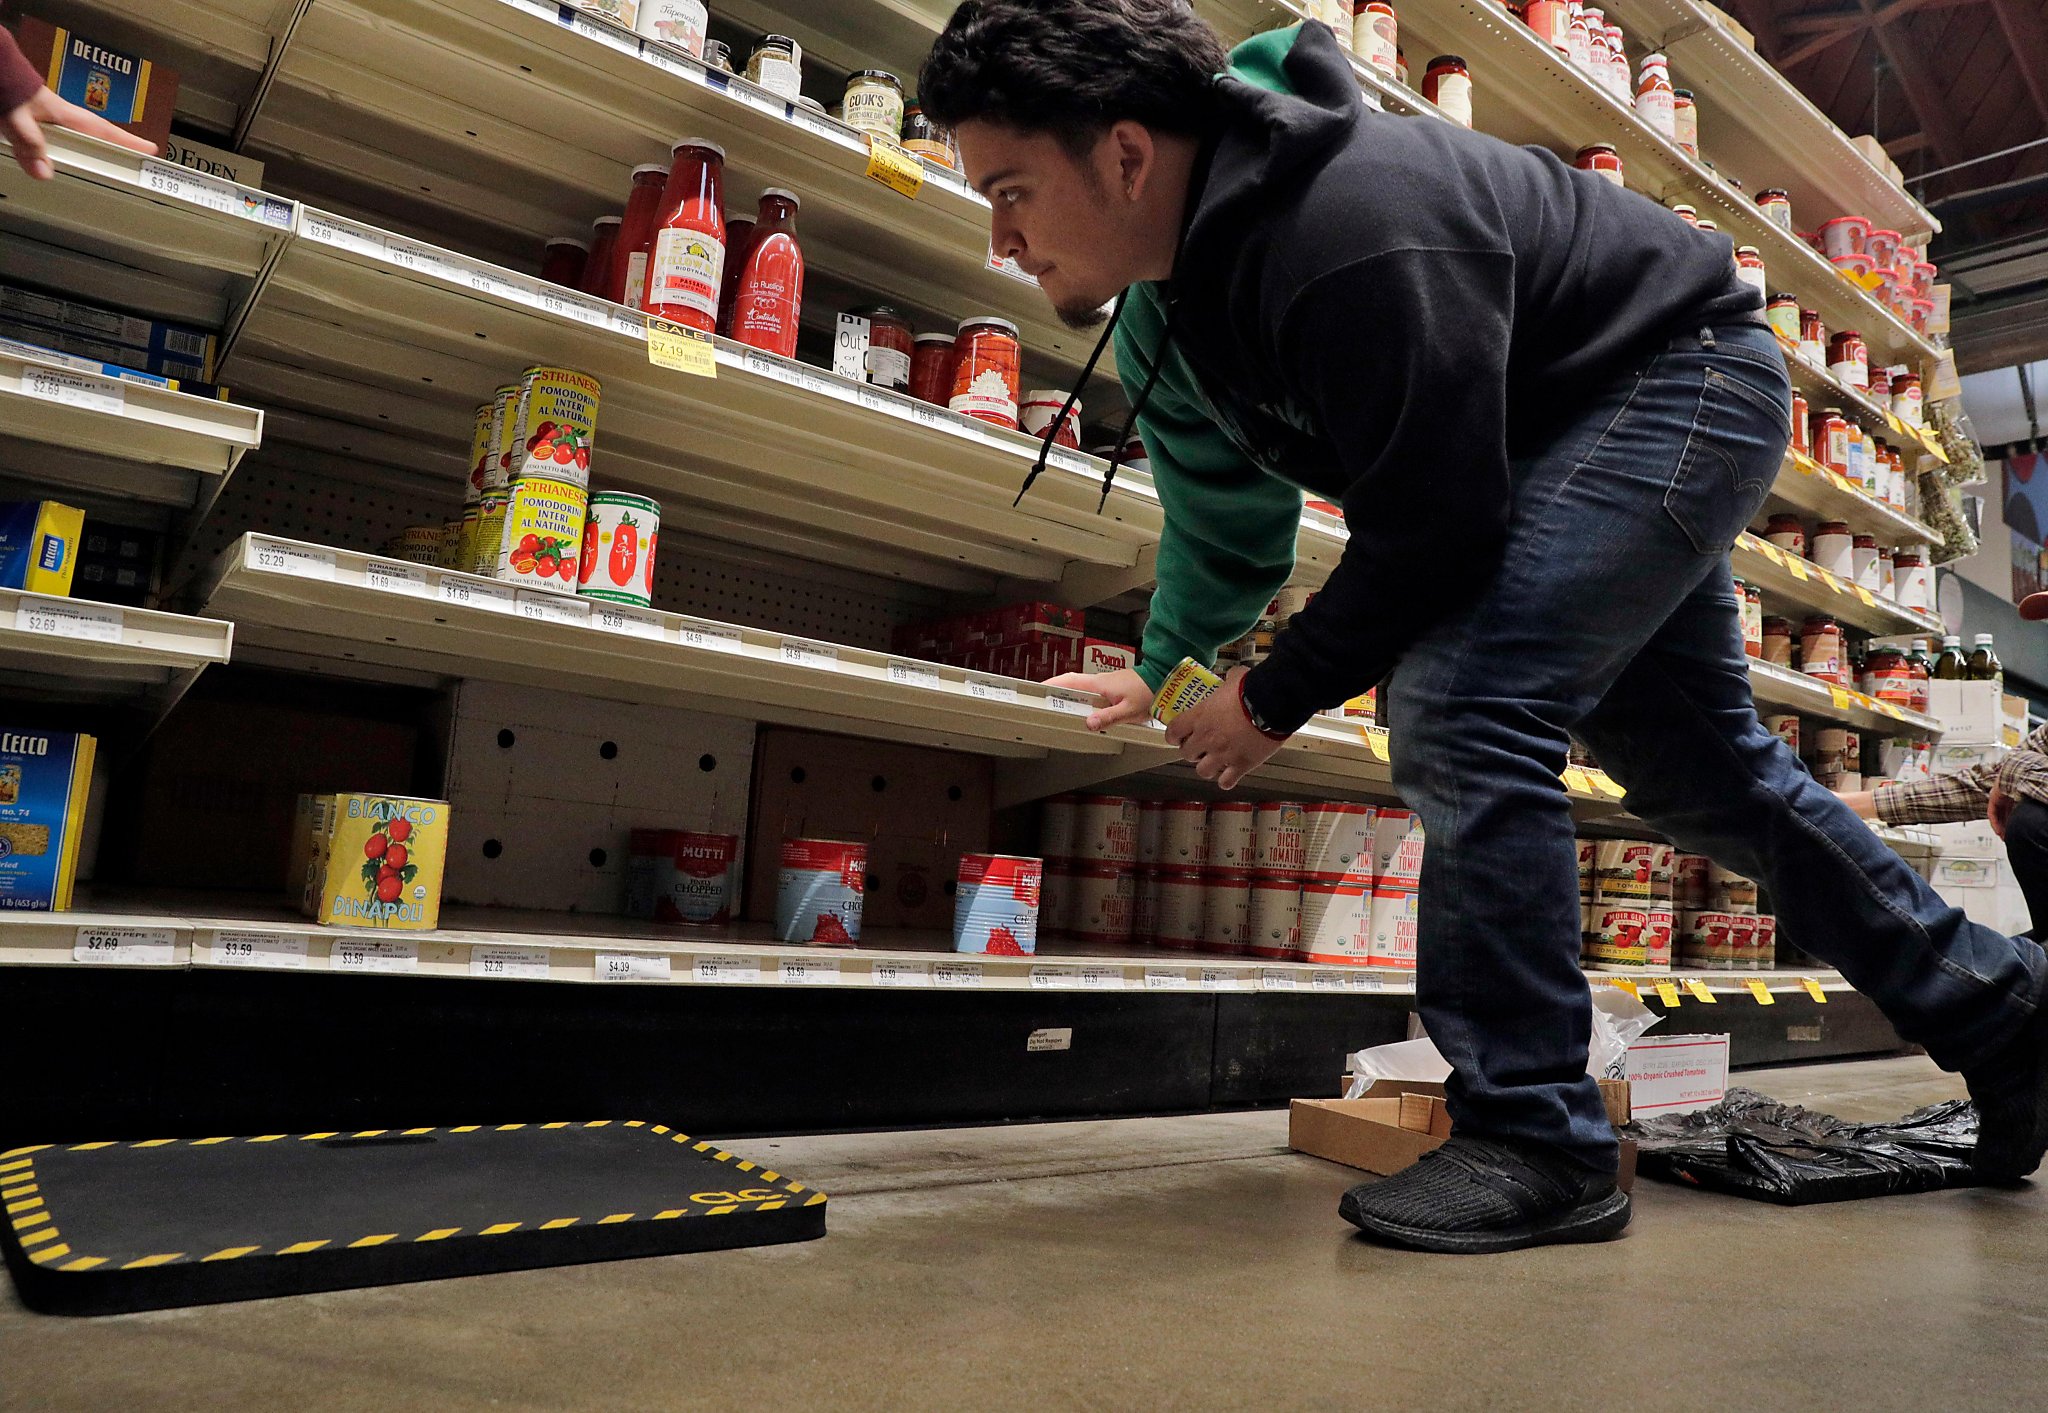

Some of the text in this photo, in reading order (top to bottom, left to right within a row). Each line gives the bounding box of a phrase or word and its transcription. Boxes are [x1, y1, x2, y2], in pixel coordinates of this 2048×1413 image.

[73, 39, 132, 75] DE CECCO
[849, 93, 884, 108] COOK'S
[180, 148, 238, 183] EDEN
[874, 152, 900, 173] $5.79
[151, 176, 179, 194] $3.99
[266, 202, 289, 213] NON
[266, 209, 288, 220] GMO
[307, 217, 362, 238] TOMATO PUREE
[310, 225, 332, 241] $2.69
[389, 244, 442, 263] TOMATO PUREE
[393, 252, 414, 266] $3.19
[675, 265, 713, 281] BIODYNAMIC
[471, 277, 491, 292] $3.19
[680, 278, 708, 291] PASSATA
[545, 298, 564, 313] $3.59
[620, 321, 639, 336] $7.79
[656, 321, 706, 341] SALE
[840, 331, 861, 351] Out
[651, 340, 683, 358] $7.19
[752, 359, 770, 373] $6.39
[28, 372, 83, 388] CAPELLINI
[33, 379, 60, 396] $2.69
[541, 370, 598, 394] STRIANESE
[540, 386, 596, 409] POMODORINI
[555, 397, 586, 413] INTERI
[538, 406, 593, 428] AL NATURALE
[919, 411, 935, 422] $5.99
[524, 481, 585, 504] STRIANESE
[523, 498, 582, 518] POMODORINI
[538, 509, 569, 524] INTERI
[521, 518, 579, 538] AL NATURALE
[46, 539, 58, 559] CECCO
[254, 546, 310, 559] TOMATO PULP
[259, 553, 284, 568] $2.29
[368, 563, 408, 573] STRIANESE
[371, 575, 389, 588] $1.69
[453, 582, 468, 590] Cherry
[470, 586, 492, 595] Tomatoes
[446, 586, 470, 601] $1.69
[524, 606, 543, 618] $2.19
[29, 616, 56, 632] $2.69
[602, 614, 623, 628] $2.69
[686, 632, 702, 643] $4.59
[786, 648, 801, 660] $4.59
[1158, 663, 1195, 711] STRIANESE
[1172, 676, 1203, 713] NATURAL
[1182, 682, 1208, 713] HERRY
[2, 733, 48, 756] CECCO
[2, 809, 30, 817] no. 74
[348, 799, 436, 825] BIANCO
[1278, 832, 1300, 848] DICED
[682, 846, 724, 860] MUTTI
[1269, 847, 1306, 864] TOMATOES
[1401, 840, 1424, 857] CRUSH
[0, 861, 19, 869] ried
[1398, 855, 1422, 872] TOMAT
[675, 883, 722, 896] CHOPPED
[15, 900, 30, 909] (453
[31, 900, 39, 910] g)
[332, 895, 424, 922] DiNAPOLI
[1609, 912, 1646, 922] MUIR GLEN
[123, 931, 148, 939] PEPE
[88, 936, 118, 950] $2.69
[225, 942, 252, 956] $3.59
[1394, 936, 1417, 952] TOMAT
[342, 952, 364, 965] $3.59
[1597, 947, 1628, 955] TOMATO
[485, 960, 503, 972] $2.29
[609, 961, 630, 973] $4.39
[701, 965, 718, 977] $2.59
[787, 966, 805, 977] $3.59
[880, 969, 896, 979] $3.59
[1629, 1068, 1706, 1082] 100% Organic Crushed Tomatoes
